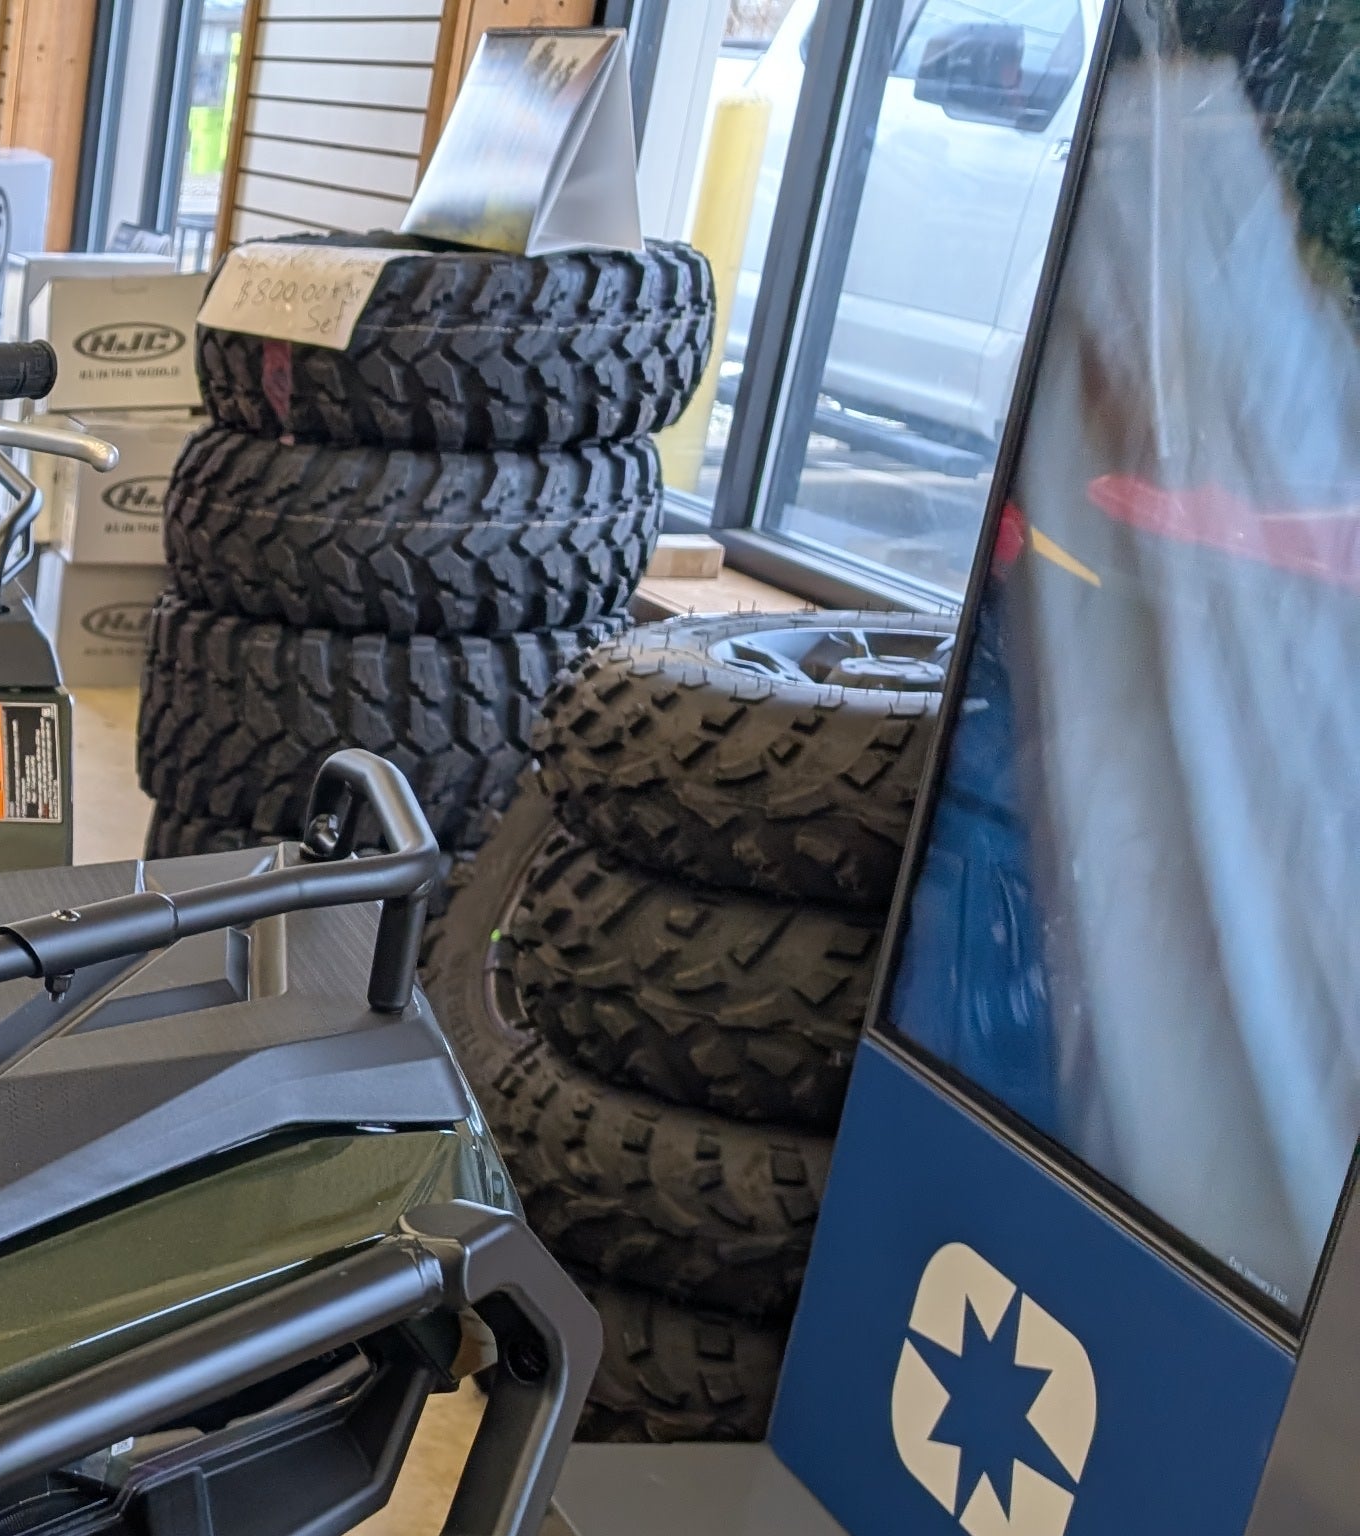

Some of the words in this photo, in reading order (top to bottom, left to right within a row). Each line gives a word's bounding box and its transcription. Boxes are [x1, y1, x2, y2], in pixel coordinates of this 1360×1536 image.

[88, 330, 171, 353] HJC
[111, 367, 133, 378] THE
[135, 365, 179, 378] WORLD
